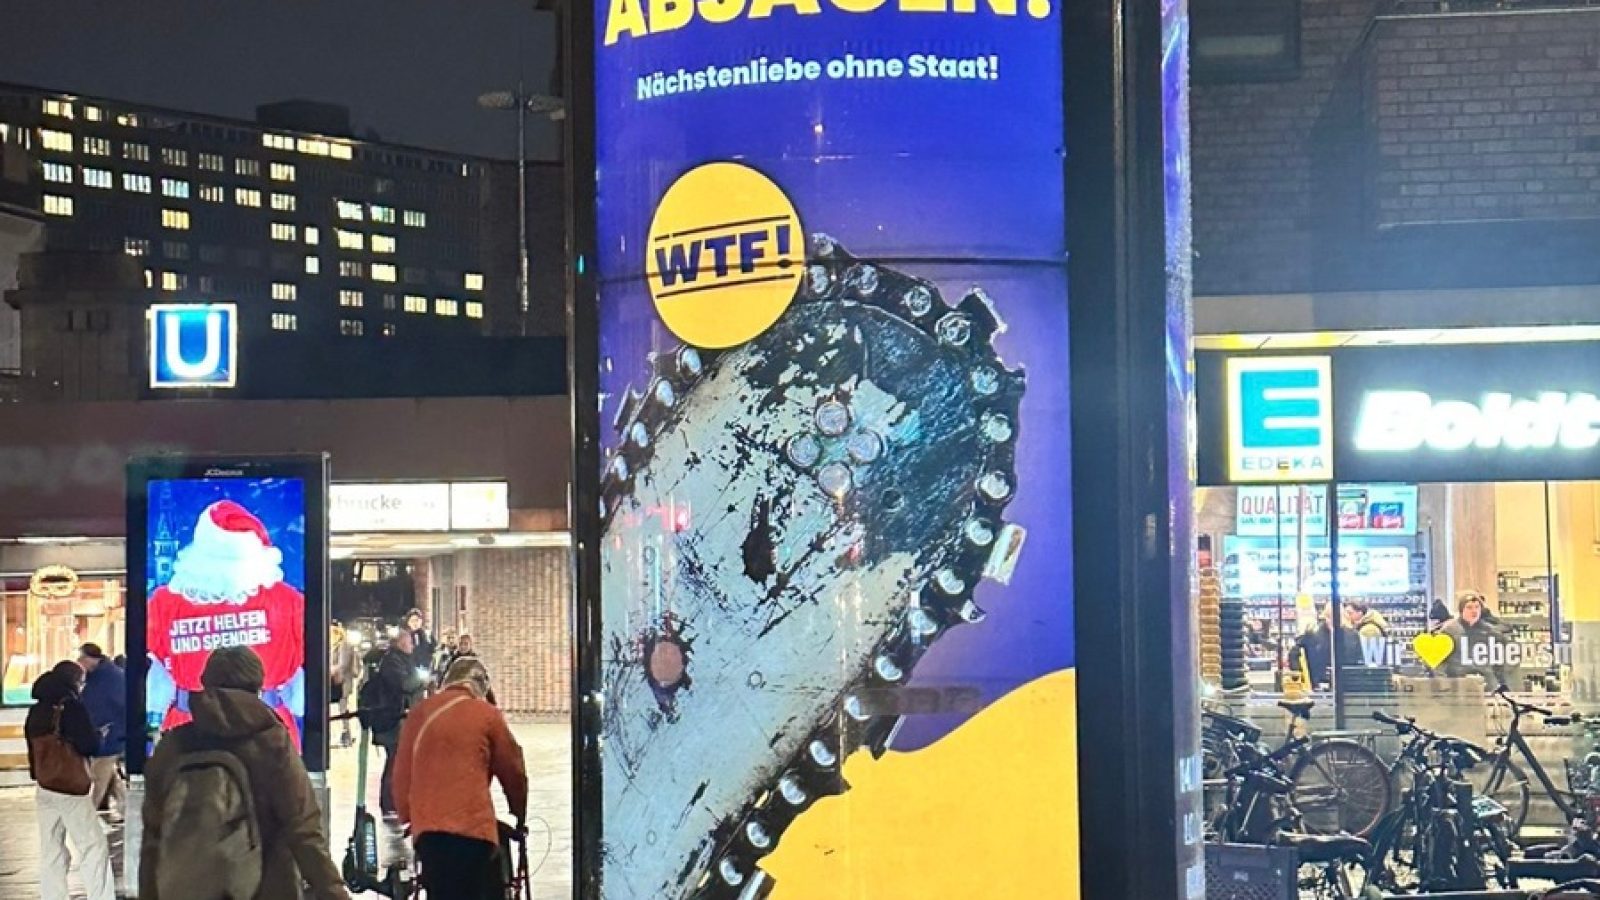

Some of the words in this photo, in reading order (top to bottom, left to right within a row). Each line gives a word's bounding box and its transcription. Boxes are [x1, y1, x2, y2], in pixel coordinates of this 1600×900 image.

[637, 56, 821, 100] Nächstenliebe
[827, 54, 903, 79] ohne
[907, 54, 998, 80] Staat!
[655, 224, 792, 287] WTF!
[165, 312, 220, 378] U
[1241, 456, 1324, 470] EDEKA
[169, 616, 212, 636] JETZT
[213, 609, 267, 631] HELFEN
[171, 635, 201, 654] UND
